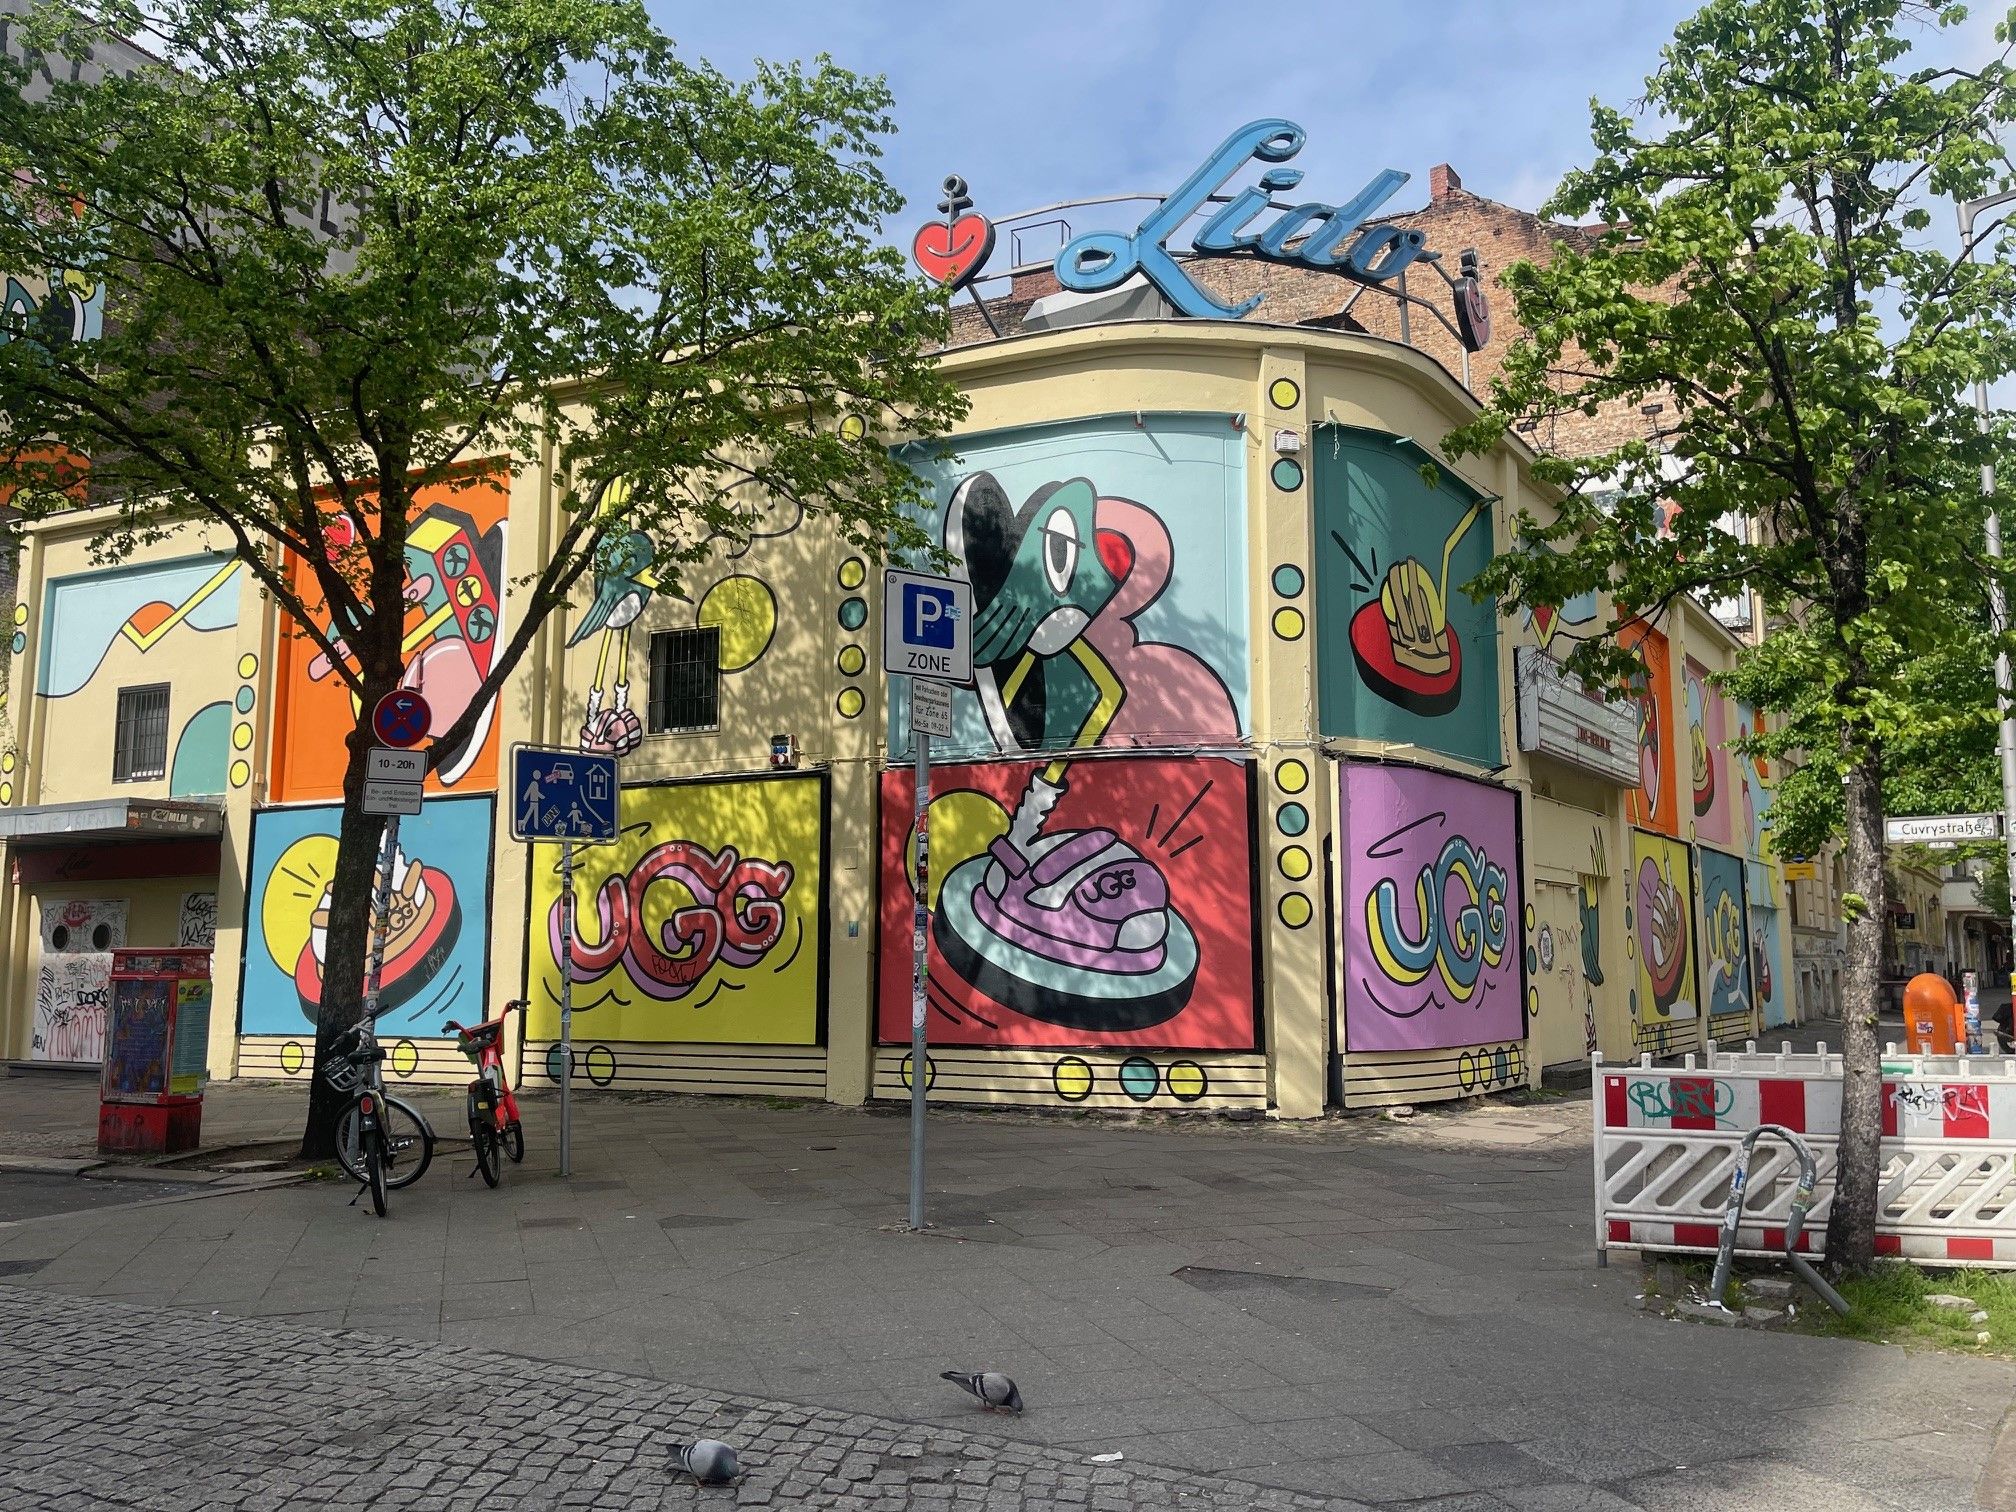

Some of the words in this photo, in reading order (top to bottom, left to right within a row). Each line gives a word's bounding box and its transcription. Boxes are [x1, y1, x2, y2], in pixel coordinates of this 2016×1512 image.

[1054, 118, 1443, 319] Lido
[916, 593, 942, 637] P
[907, 652, 951, 673] ZONE
[926, 708, 939, 719] Zone
[1902, 821, 1982, 837] Cuvrystraße
[1081, 868, 1137, 904] UGG
[548, 840, 794, 1002] UGG
[1365, 835, 1508, 1003] UGG
[1704, 889, 1741, 987] UGG
